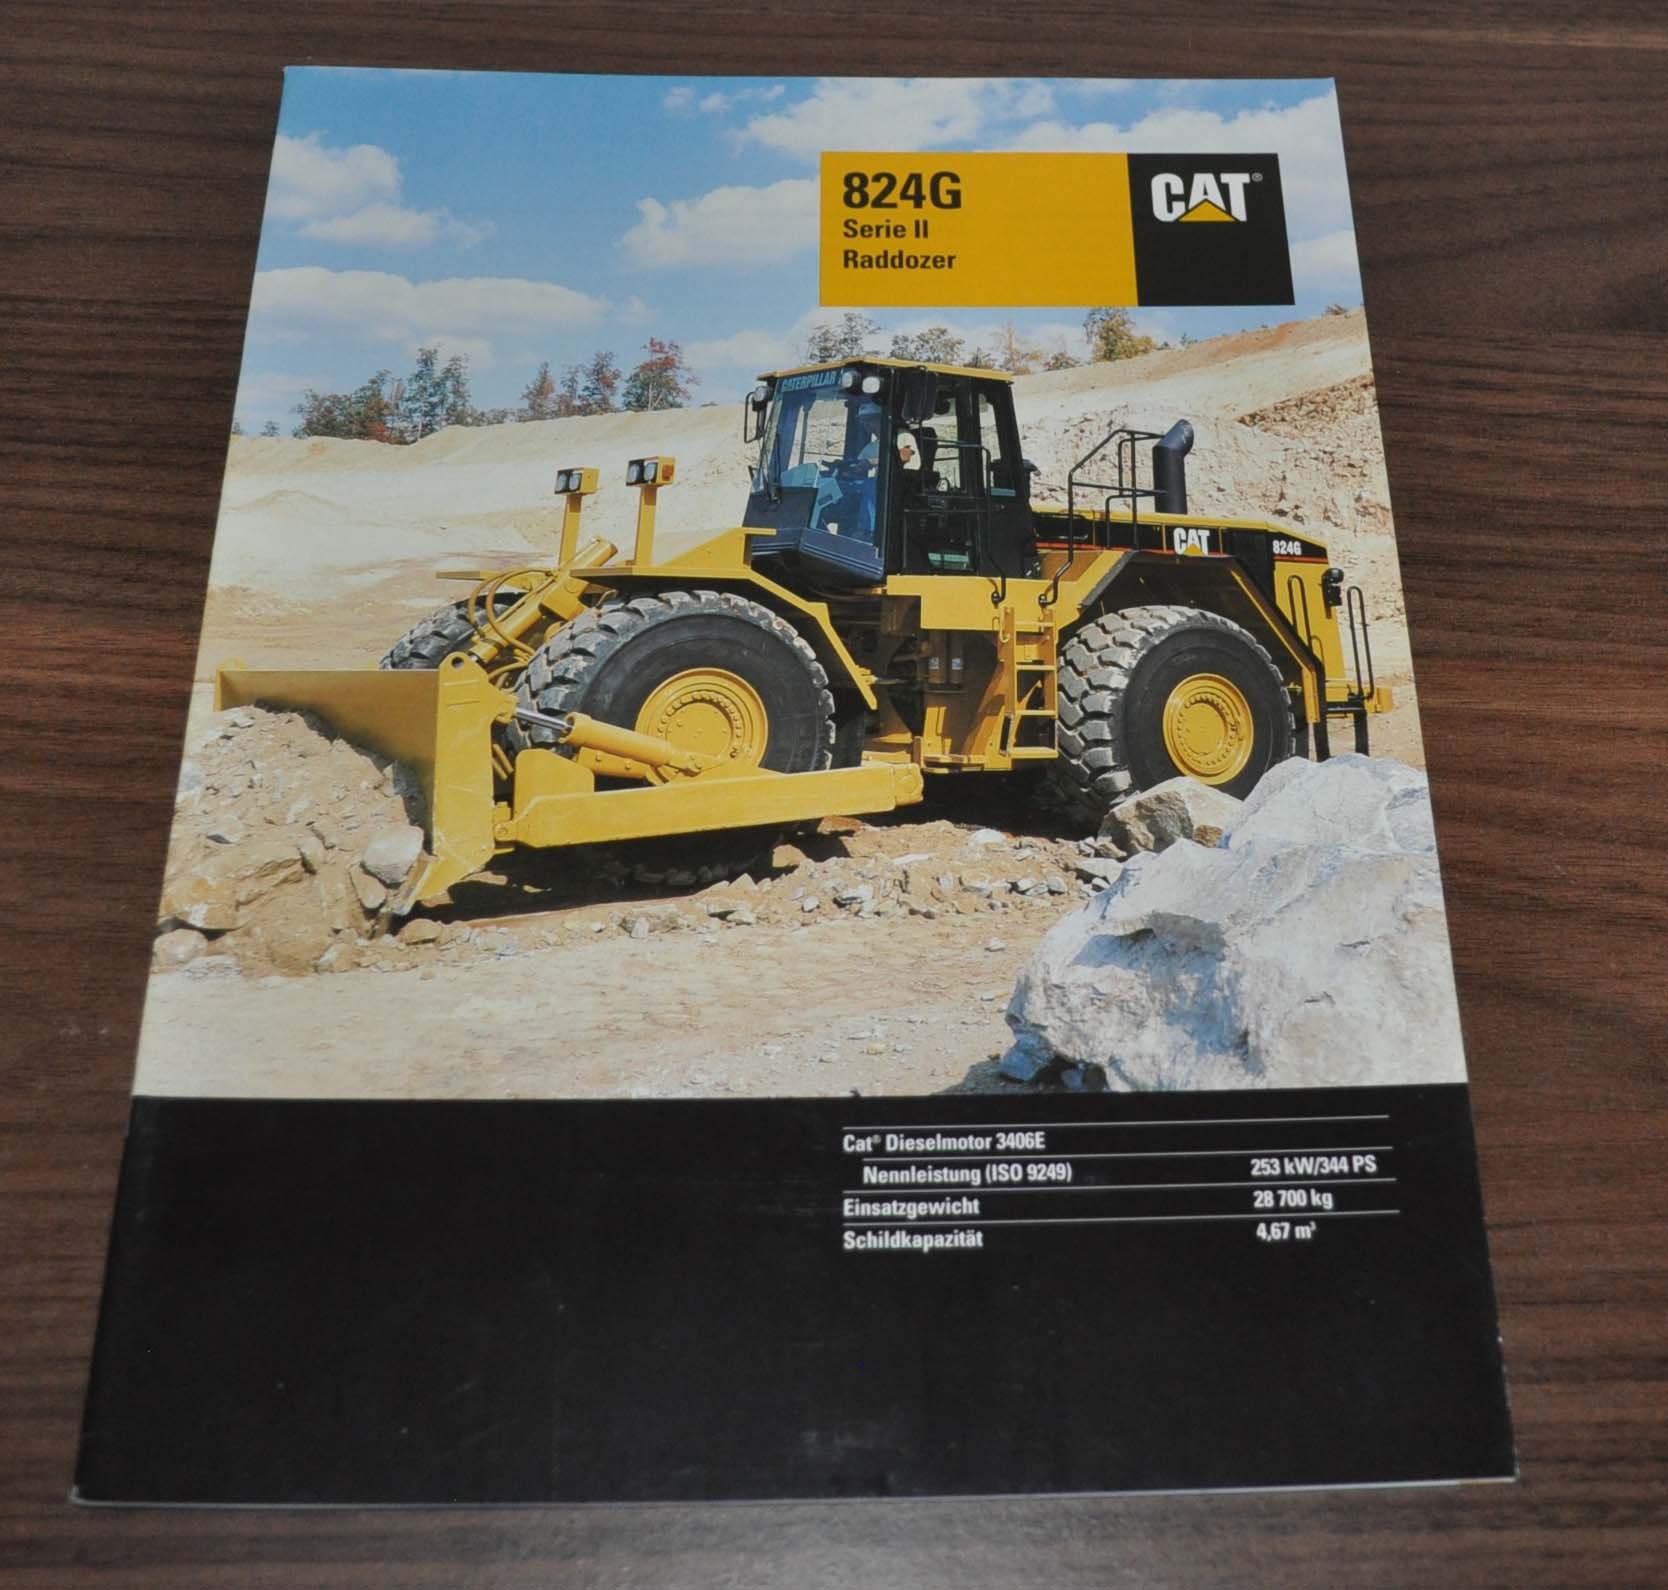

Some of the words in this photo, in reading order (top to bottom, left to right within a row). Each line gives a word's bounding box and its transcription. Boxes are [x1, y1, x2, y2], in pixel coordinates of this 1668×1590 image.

[842, 171, 963, 210] 824G
[842, 218, 907, 240] Serie
[914, 219, 930, 239] II
[842, 249, 957, 270] Raddozer
[1173, 527, 1211, 557] CAT
[1272, 539, 1303, 556] 824G
[885, 1133, 993, 1151] Dieselmotor
[996, 1131, 1046, 1150] 3406E
[863, 1165, 982, 1186] Nennleistung
[985, 1163, 1023, 1184] (ISO
[1027, 1162, 1073, 1182] 9249)
[1250, 1158, 1282, 1176] 253
[1284, 1156, 1350, 1176] kW/344
[1352, 1154, 1378, 1173] PS
[843, 1197, 981, 1220] Einsatzgewicht
[1252, 1190, 1275, 1209] 28
[1277, 1189, 1308, 1208] 700
[1310, 1188, 1334, 1210] kg
[843, 1229, 984, 1253] Schildkapazität
[1256, 1222, 1291, 1242] 4,67
